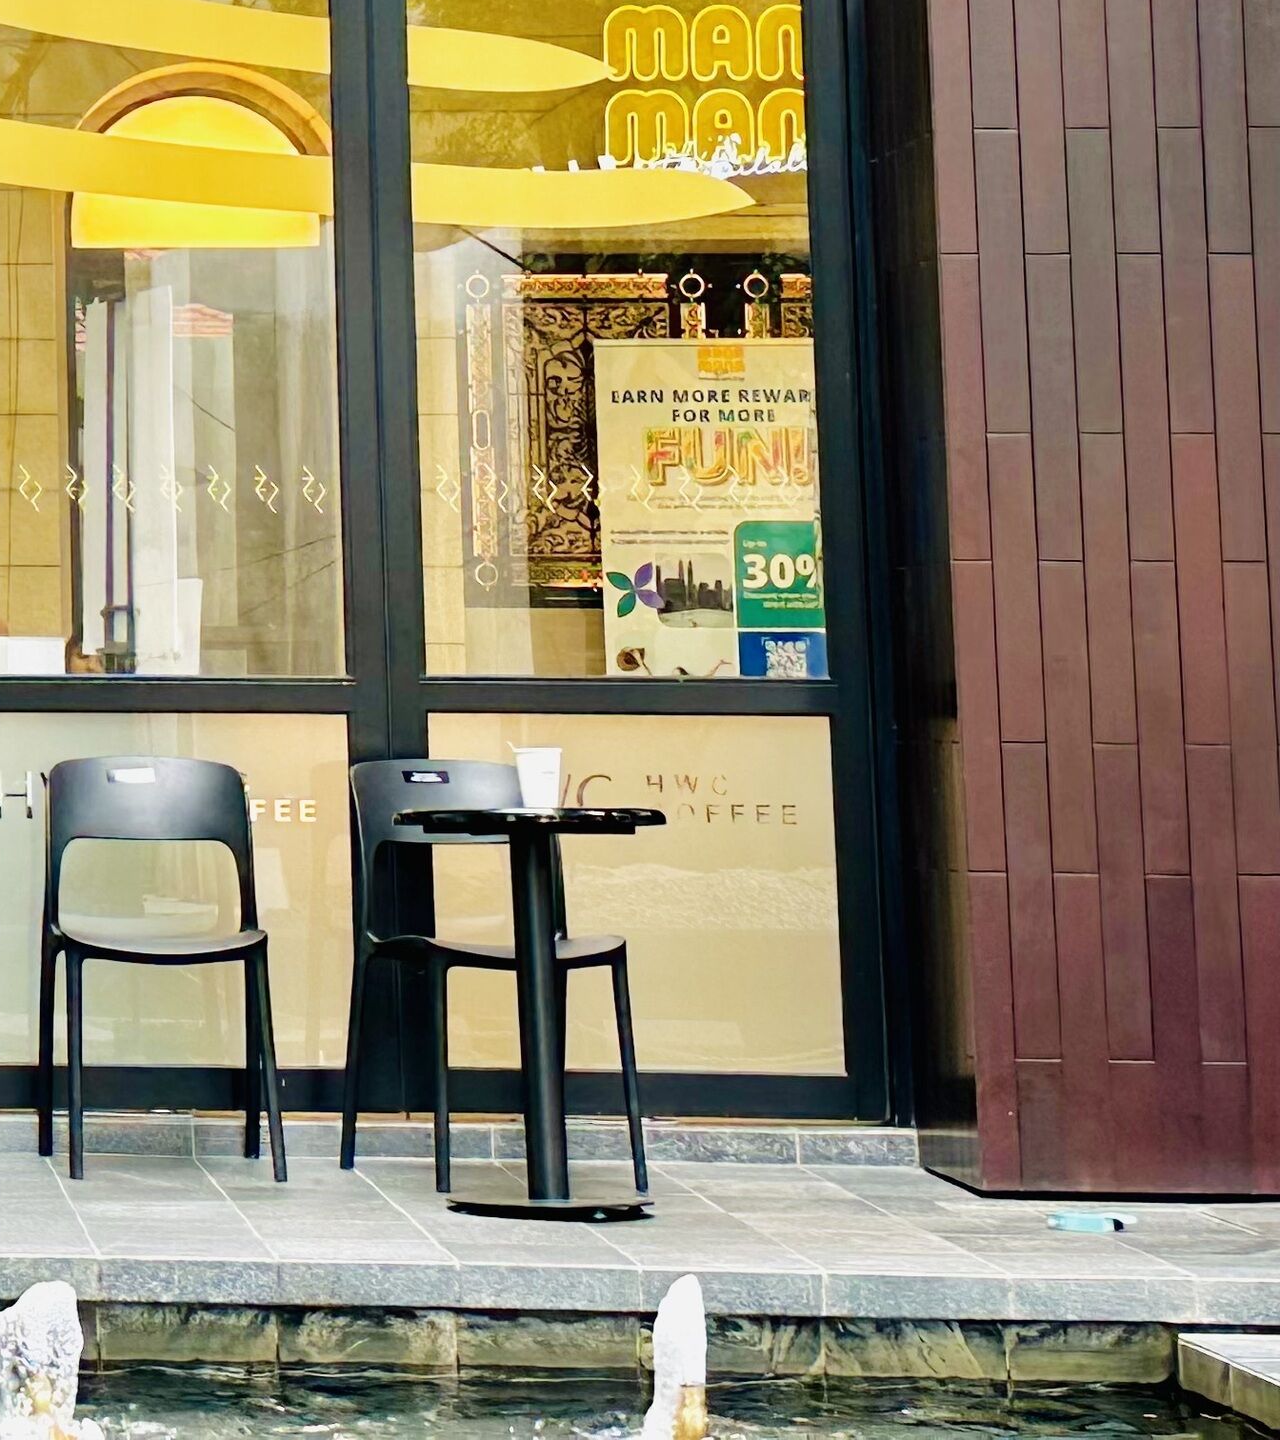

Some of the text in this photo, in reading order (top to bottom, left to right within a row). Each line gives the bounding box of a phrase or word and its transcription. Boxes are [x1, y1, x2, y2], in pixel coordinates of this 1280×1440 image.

[603, 4, 803, 82] MAN
[611, 388, 664, 404] EARN
[672, 388, 730, 404] MORE
[671, 408, 776, 423] FOR MORE
[645, 426, 814, 487] FUN!
[249, 798, 317, 823] FEE
